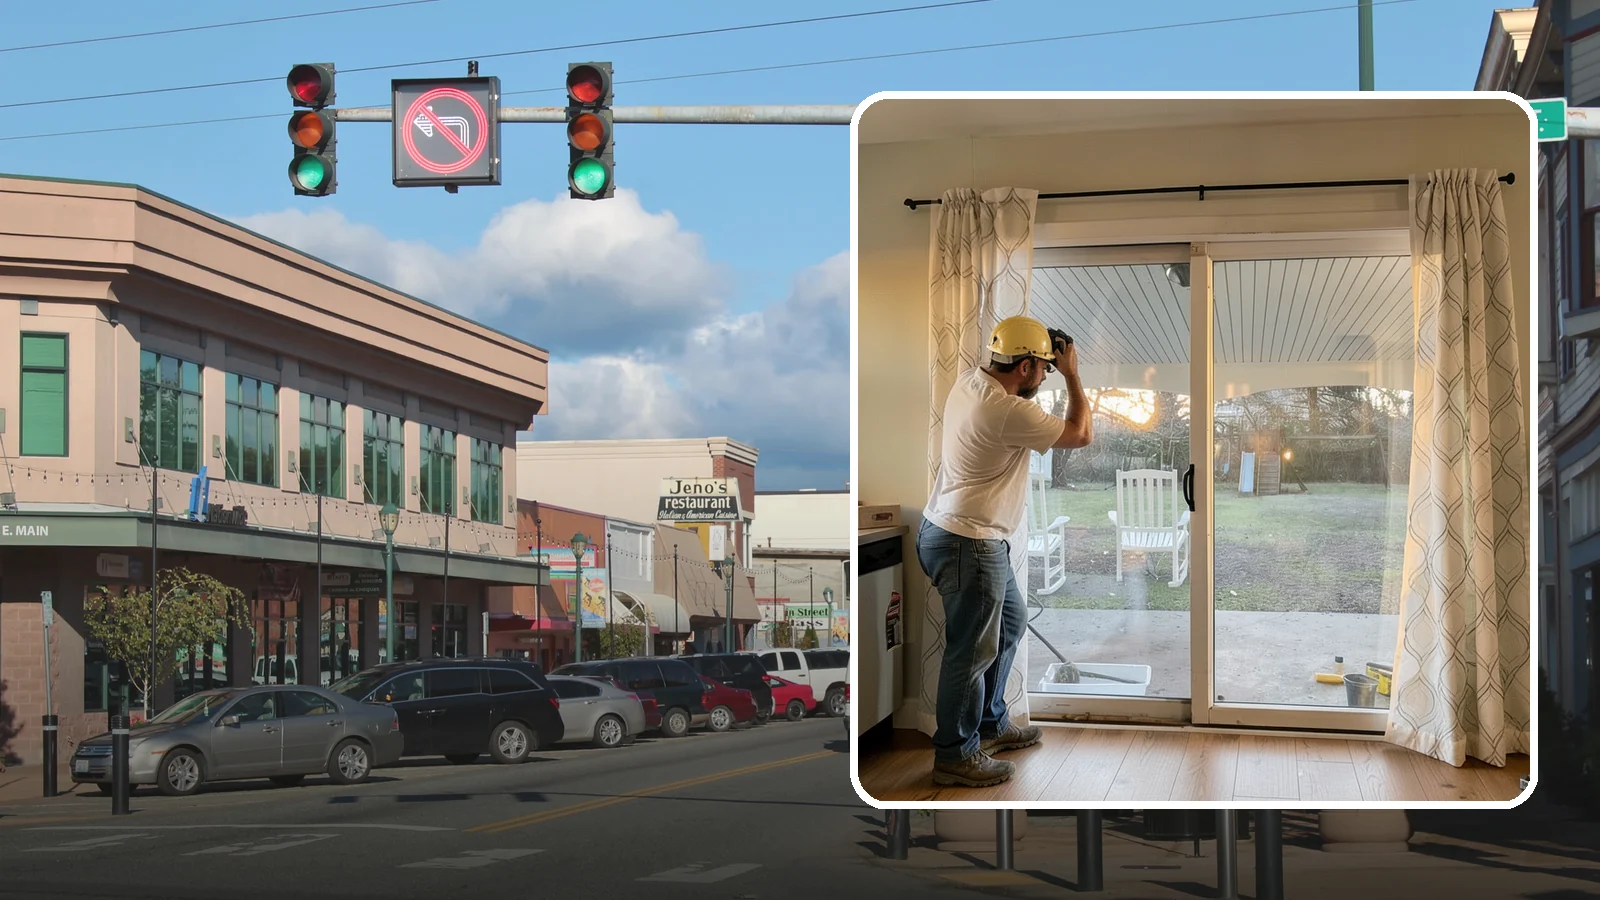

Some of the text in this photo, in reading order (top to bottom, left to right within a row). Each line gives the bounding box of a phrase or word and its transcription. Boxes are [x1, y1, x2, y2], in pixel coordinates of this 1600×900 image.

[669, 480, 728, 494] Jeno's
[665, 496, 731, 509] restaurant
[658, 509, 681, 520] Italian
[685, 509, 715, 519] American
[714, 509, 738, 519] Cuisine
[2, 525, 49, 536] E. MAIN
[797, 607, 829, 617] Street
